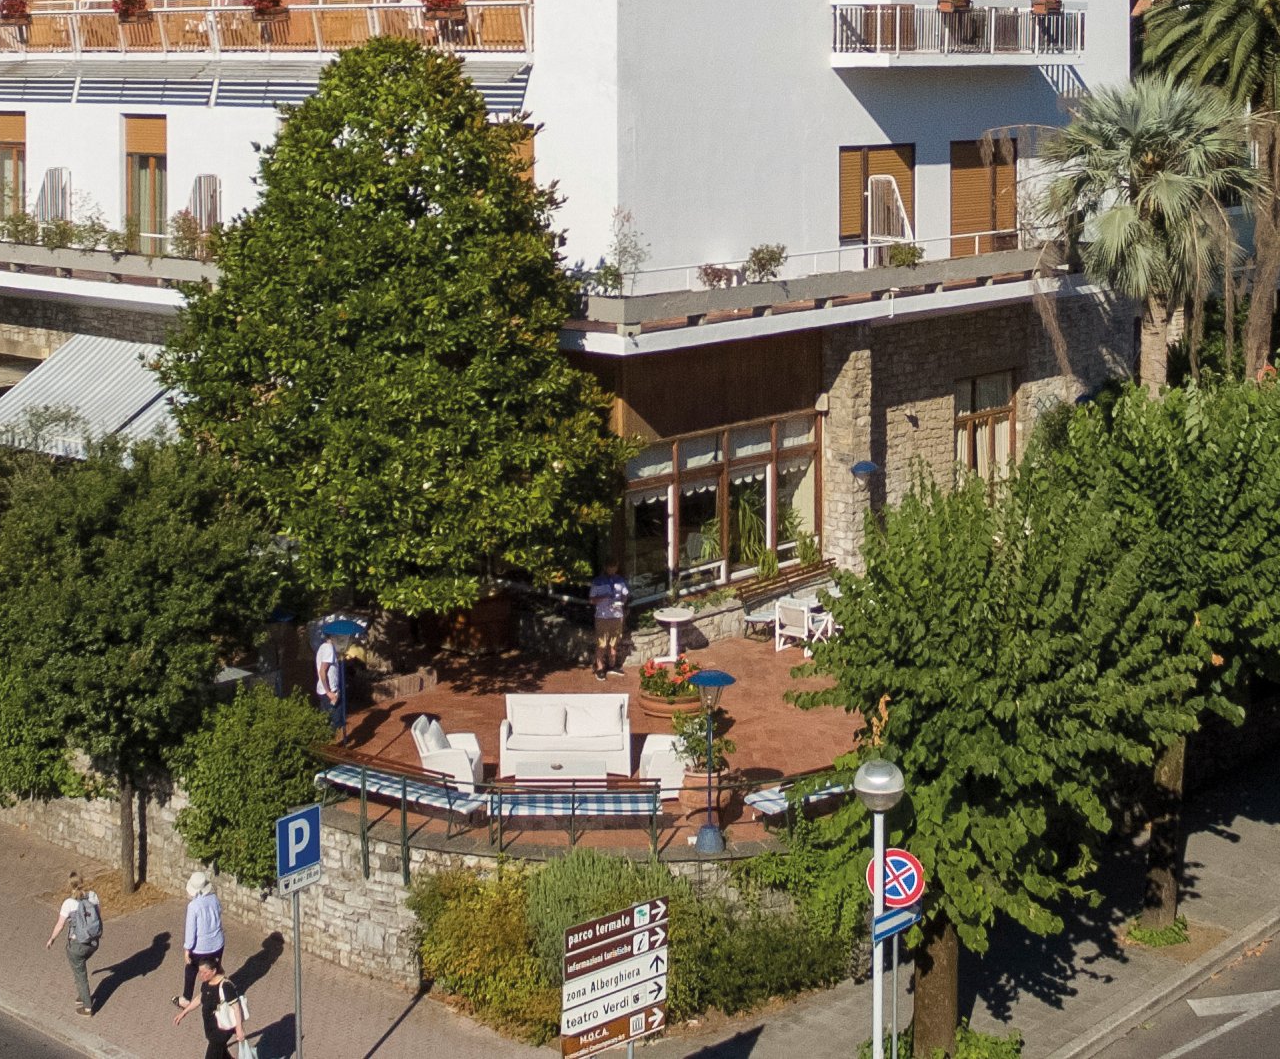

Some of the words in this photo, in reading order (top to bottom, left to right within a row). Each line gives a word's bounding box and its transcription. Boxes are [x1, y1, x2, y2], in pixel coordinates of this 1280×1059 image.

[288, 818, 310, 868] P
[568, 929, 593, 949] parco
[595, 915, 631, 936] termale
[567, 953, 603, 973] informazioni
[567, 987, 587, 1002] zona
[590, 967, 640, 993] Alberghiera
[566, 1009, 599, 1029] teatro
[603, 995, 629, 1015] Verdi
